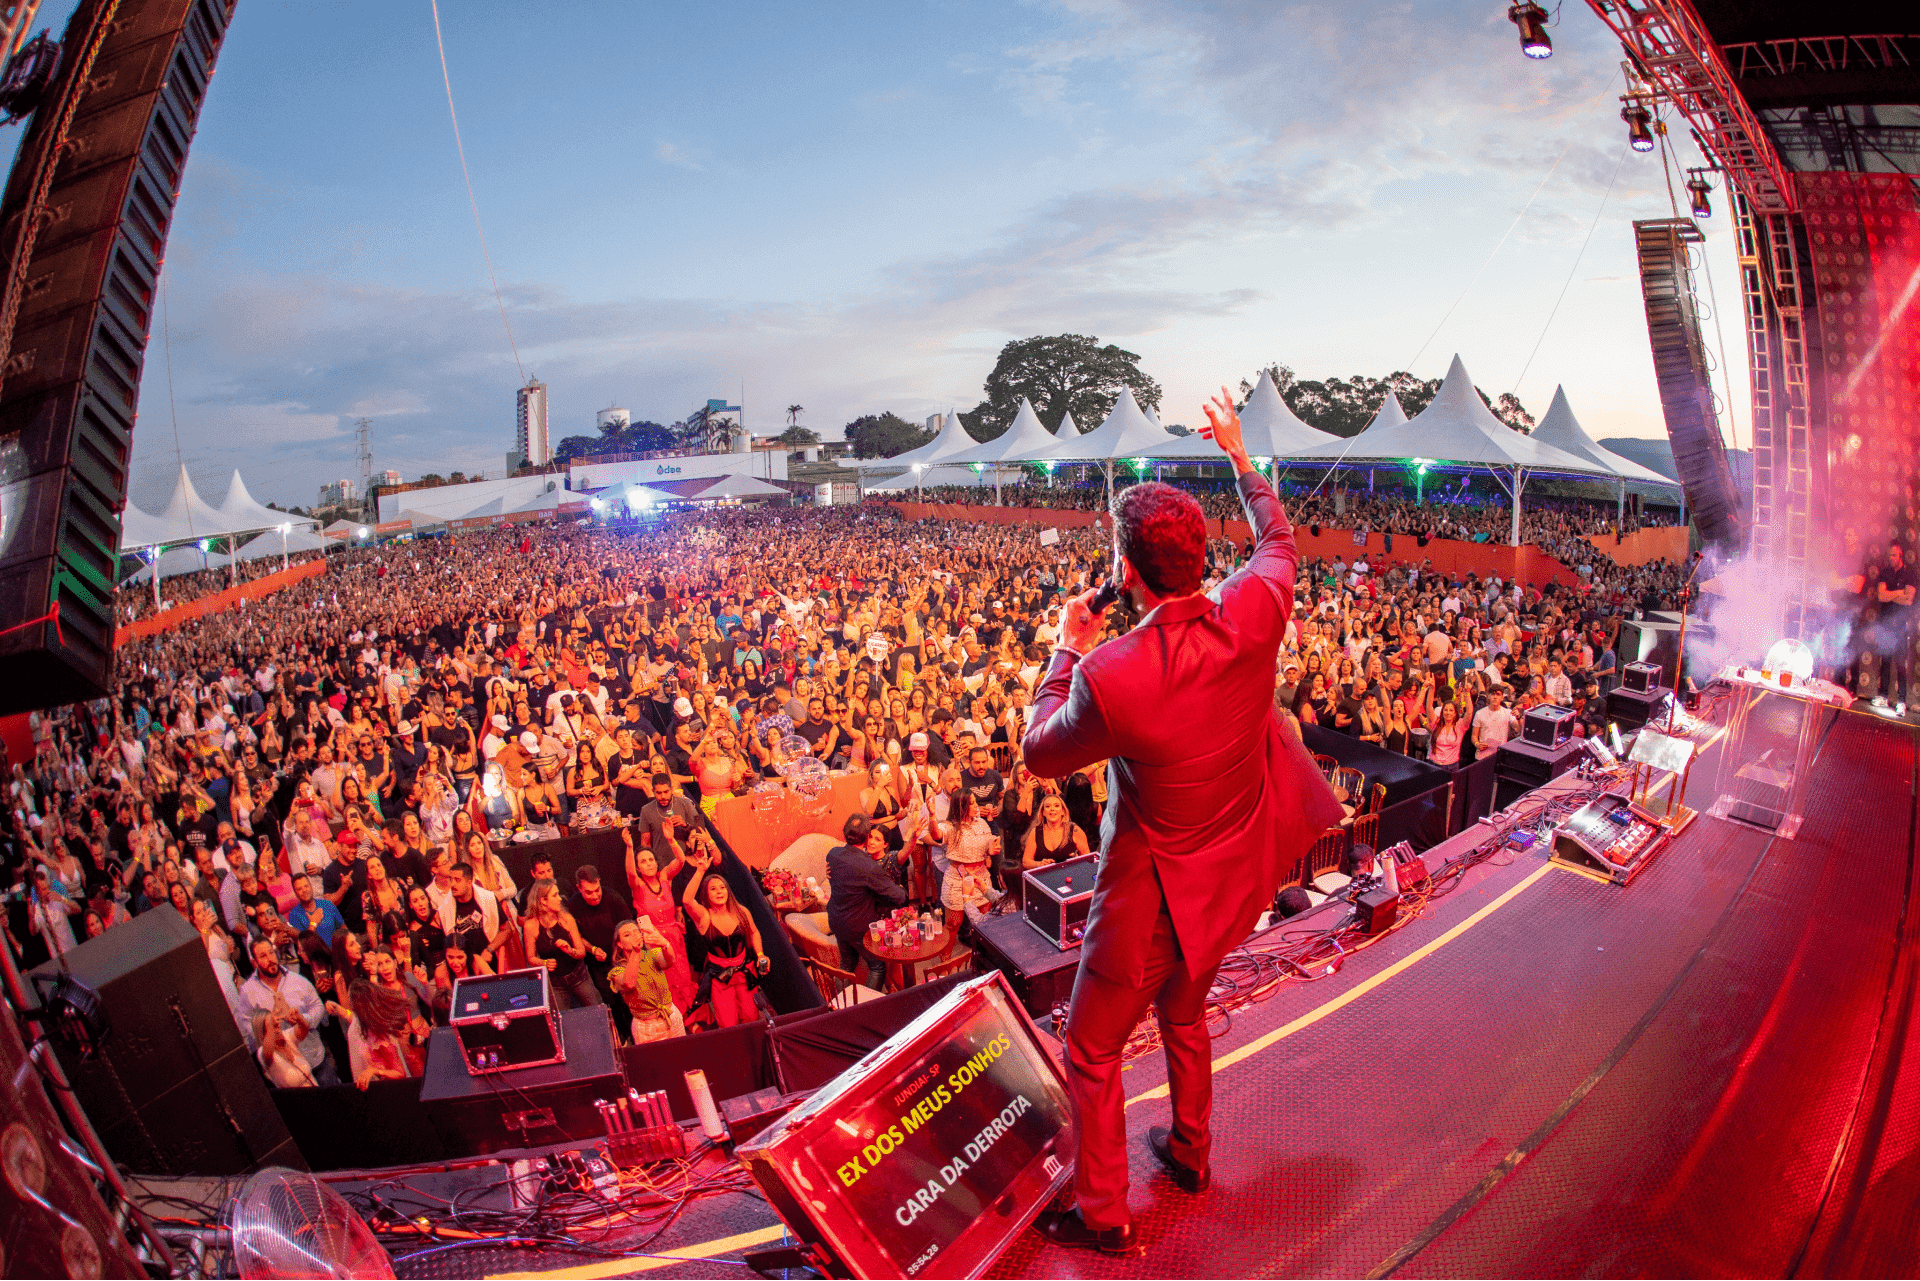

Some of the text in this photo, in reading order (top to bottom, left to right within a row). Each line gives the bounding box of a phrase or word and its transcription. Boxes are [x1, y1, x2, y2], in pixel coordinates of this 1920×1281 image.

[836, 1032, 1011, 1188] EX DOS MEUS SONHOS
[928, 1063, 940, 1078] SP
[895, 1094, 1032, 1226] CARA DA DERROTA
